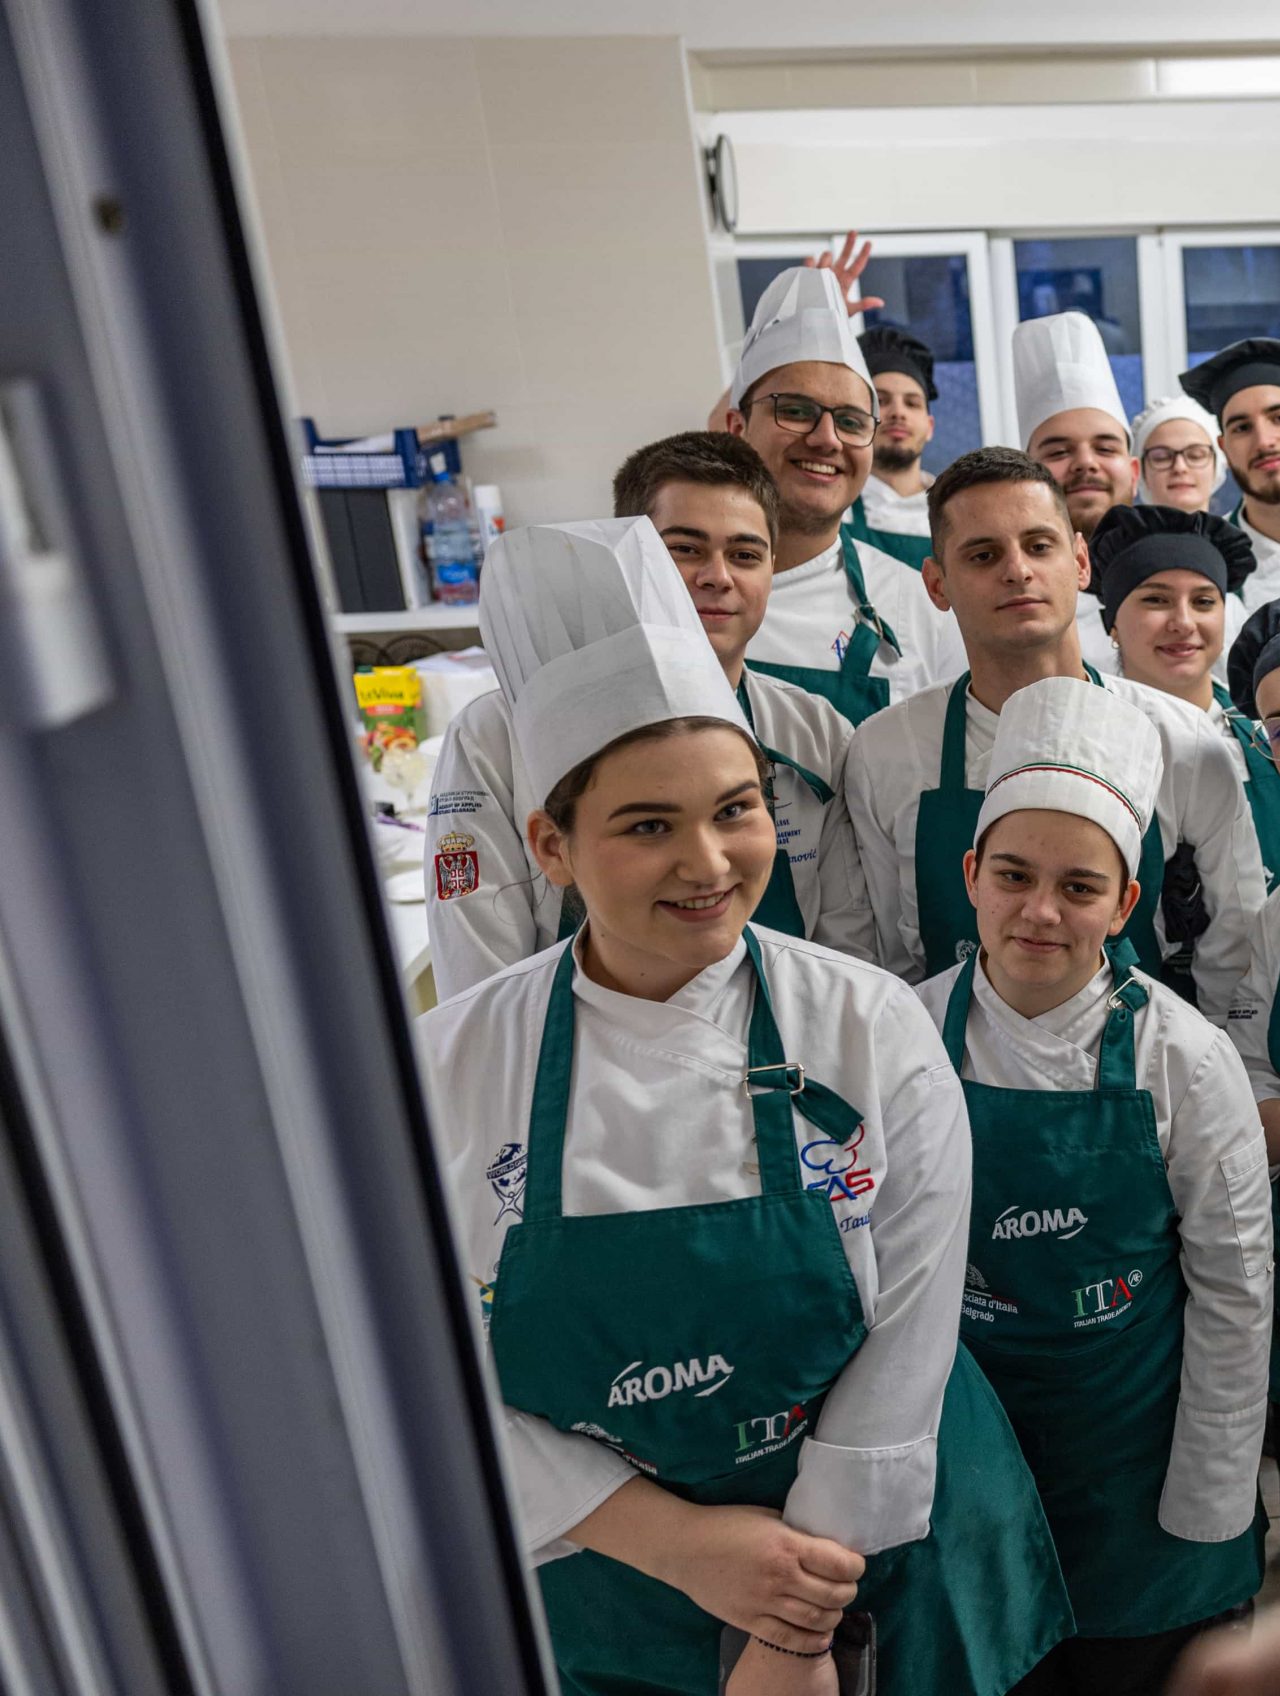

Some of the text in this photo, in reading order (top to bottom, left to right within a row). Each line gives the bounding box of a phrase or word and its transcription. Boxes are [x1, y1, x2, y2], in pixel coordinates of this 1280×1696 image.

[777, 829, 801, 838] AGEMENT
[991, 1207, 1089, 1240] AROMA
[962, 1293, 1019, 1314] sciata d'Italia
[1072, 1276, 1134, 1319] ITA
[608, 1353, 735, 1408] AROMA
